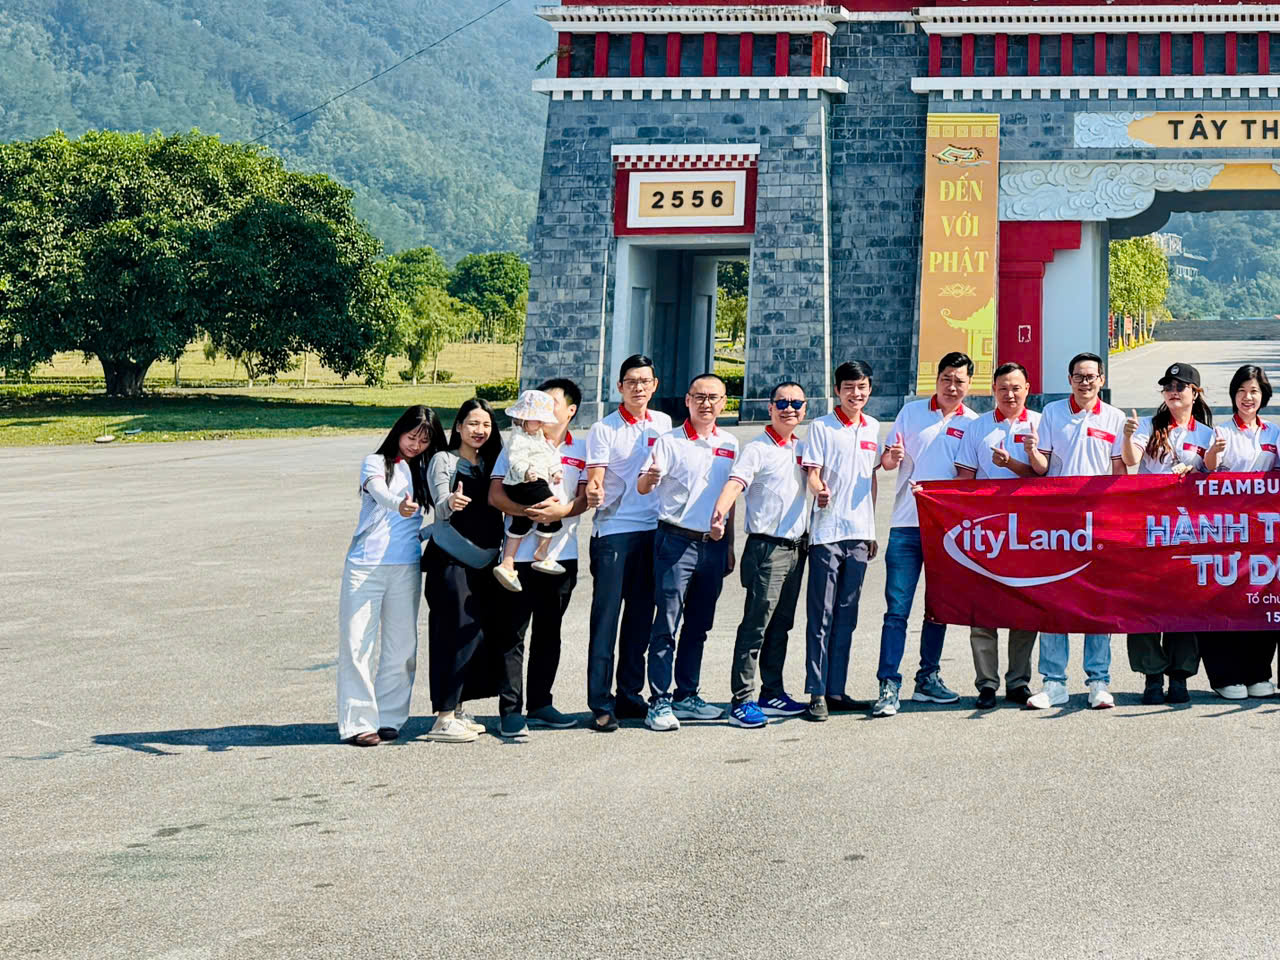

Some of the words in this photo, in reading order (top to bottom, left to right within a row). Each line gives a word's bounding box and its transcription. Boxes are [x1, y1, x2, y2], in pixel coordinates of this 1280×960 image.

[1168, 113, 1228, 140] TÂY
[651, 190, 724, 209] 2556
[939, 172, 984, 202] ĐẾN
[941, 211, 979, 237] VỚI
[928, 246, 990, 277] PHẬT
[1146, 507, 1249, 547] HÀNH
[1172, 551, 1242, 586] TƯ
[1246, 592, 1261, 605] Tổ
